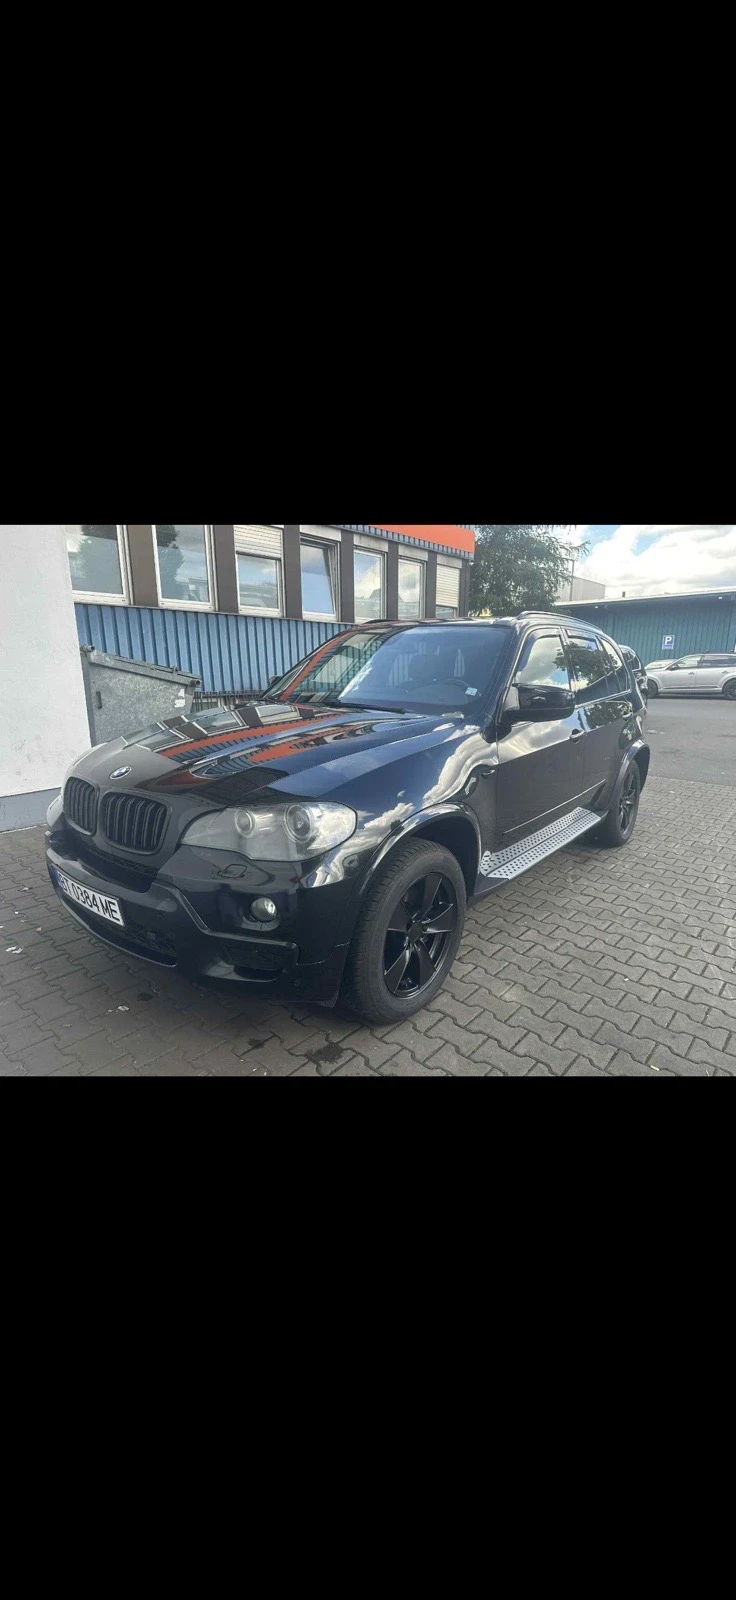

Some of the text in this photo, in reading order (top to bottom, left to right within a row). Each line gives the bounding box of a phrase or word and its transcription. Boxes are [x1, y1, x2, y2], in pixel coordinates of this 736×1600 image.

[664, 636, 673, 646] P
[71, 883, 100, 912] 0384
[99, 897, 121, 922] ME
